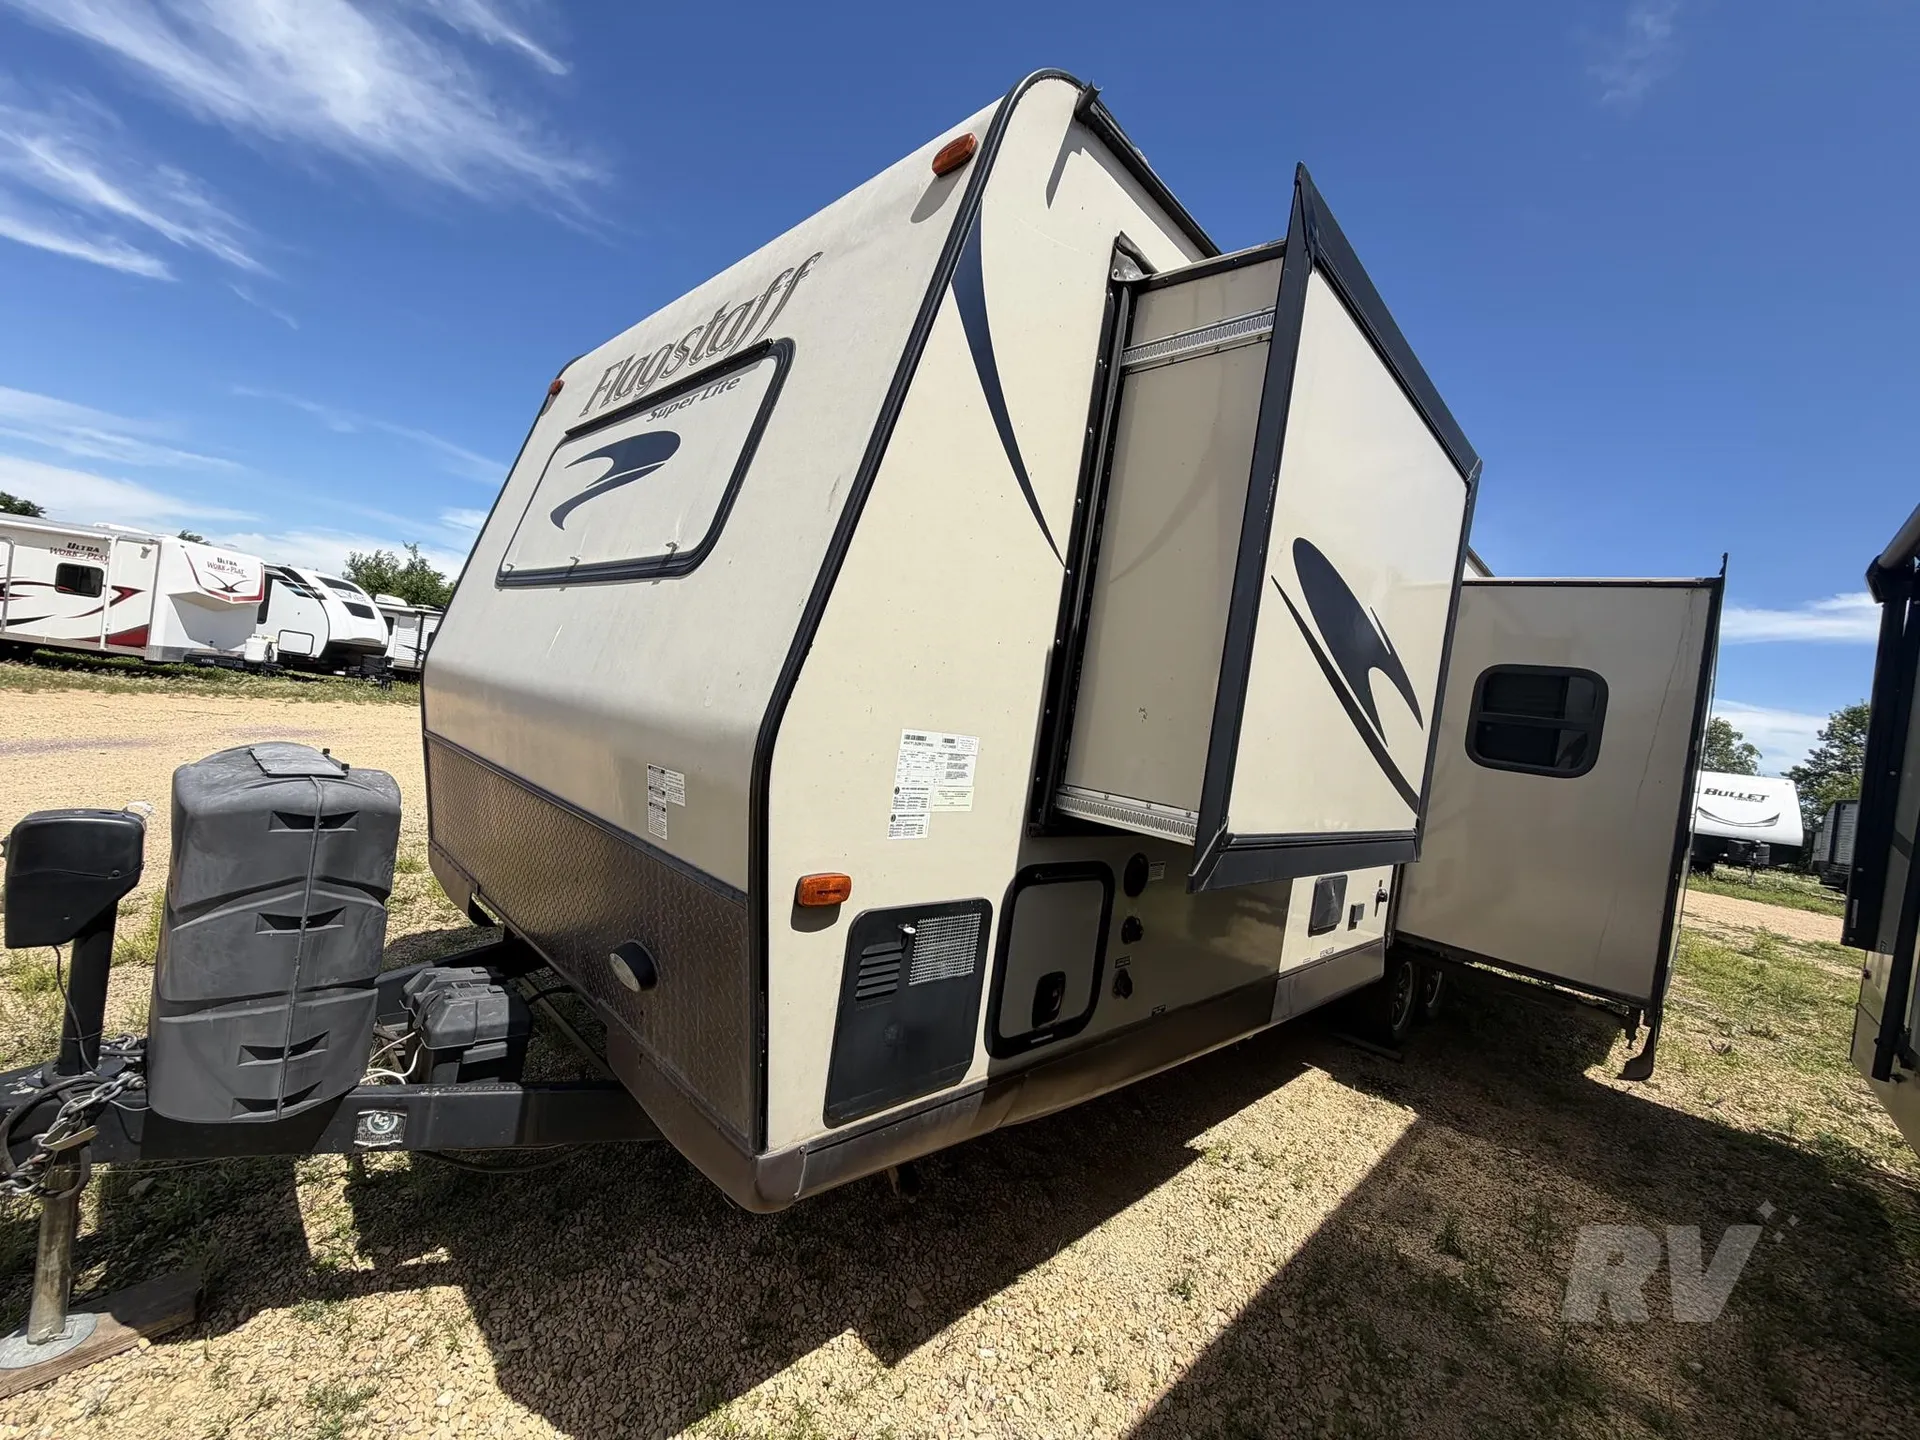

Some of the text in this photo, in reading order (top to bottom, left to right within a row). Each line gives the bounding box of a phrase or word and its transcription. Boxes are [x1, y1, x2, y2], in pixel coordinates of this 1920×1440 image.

[578, 251, 824, 418] Flagstaff
[646, 377, 741, 423] Super Lite
[1704, 788, 1769, 801] BULLET
